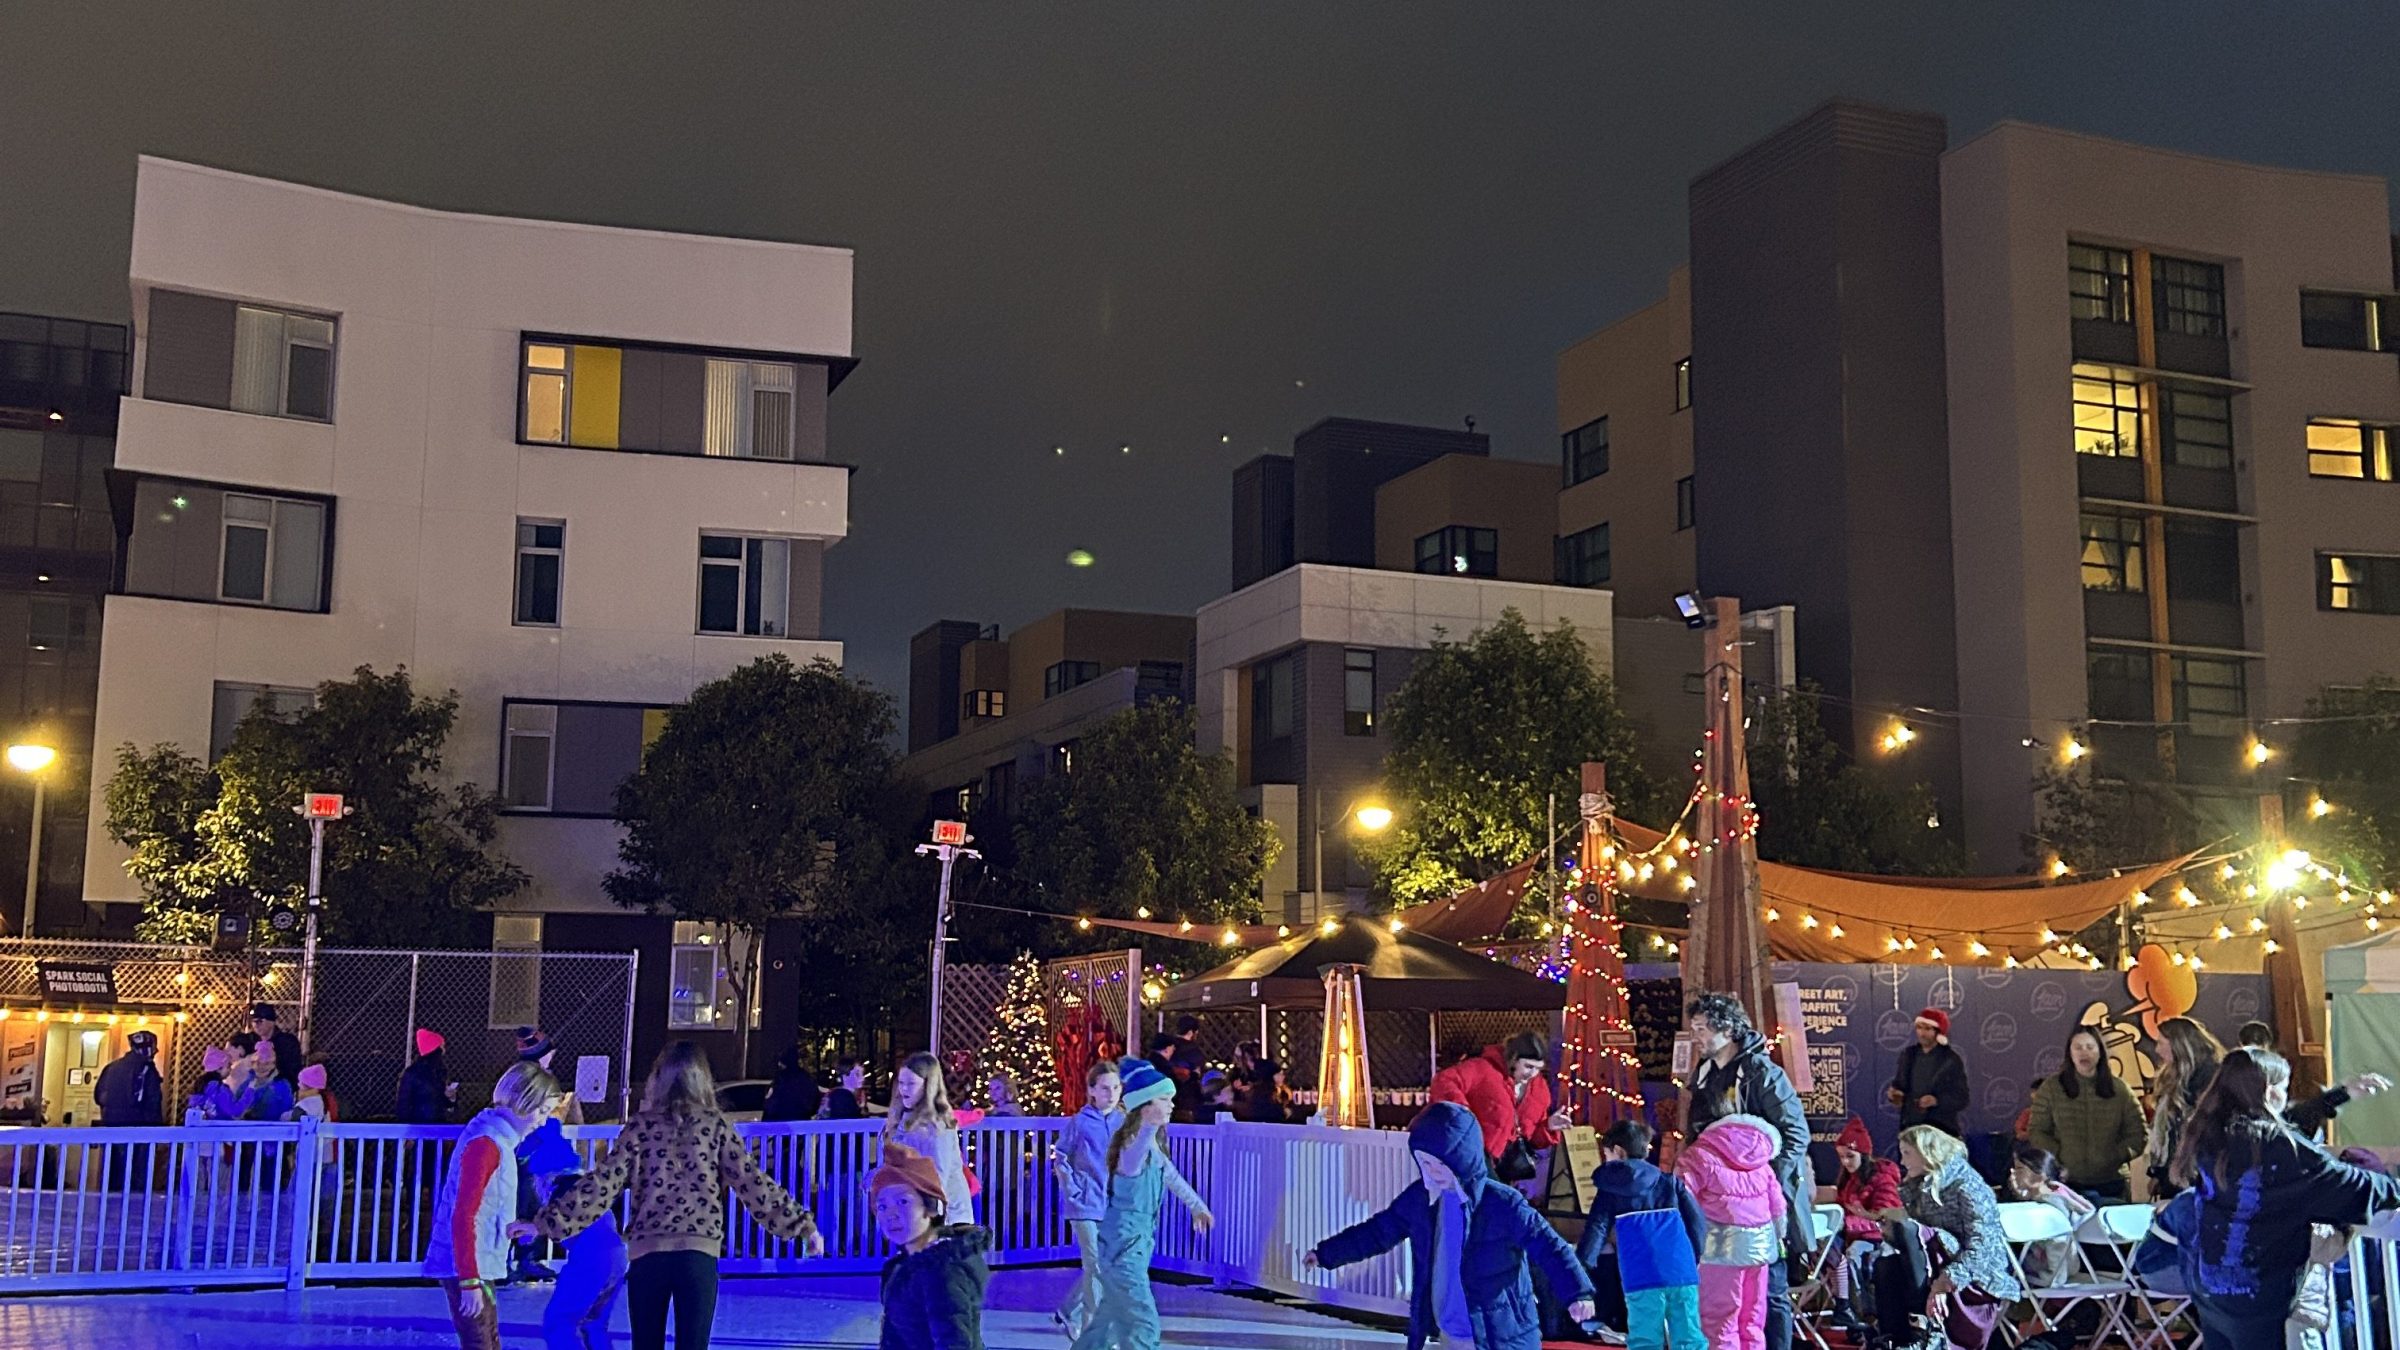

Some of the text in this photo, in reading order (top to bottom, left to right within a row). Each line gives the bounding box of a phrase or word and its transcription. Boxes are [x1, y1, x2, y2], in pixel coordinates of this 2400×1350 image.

[45, 970, 108, 982] SPARK SOCIAL
[49, 981, 108, 993] PHOTOBOOTH
[1799, 988, 1847, 1001] REET ART,
[1801, 1002, 1841, 1013] RAFFITI,
[1802, 1015, 1848, 1026] PERIENCE
[1807, 1047, 1841, 1056] OK NOW
